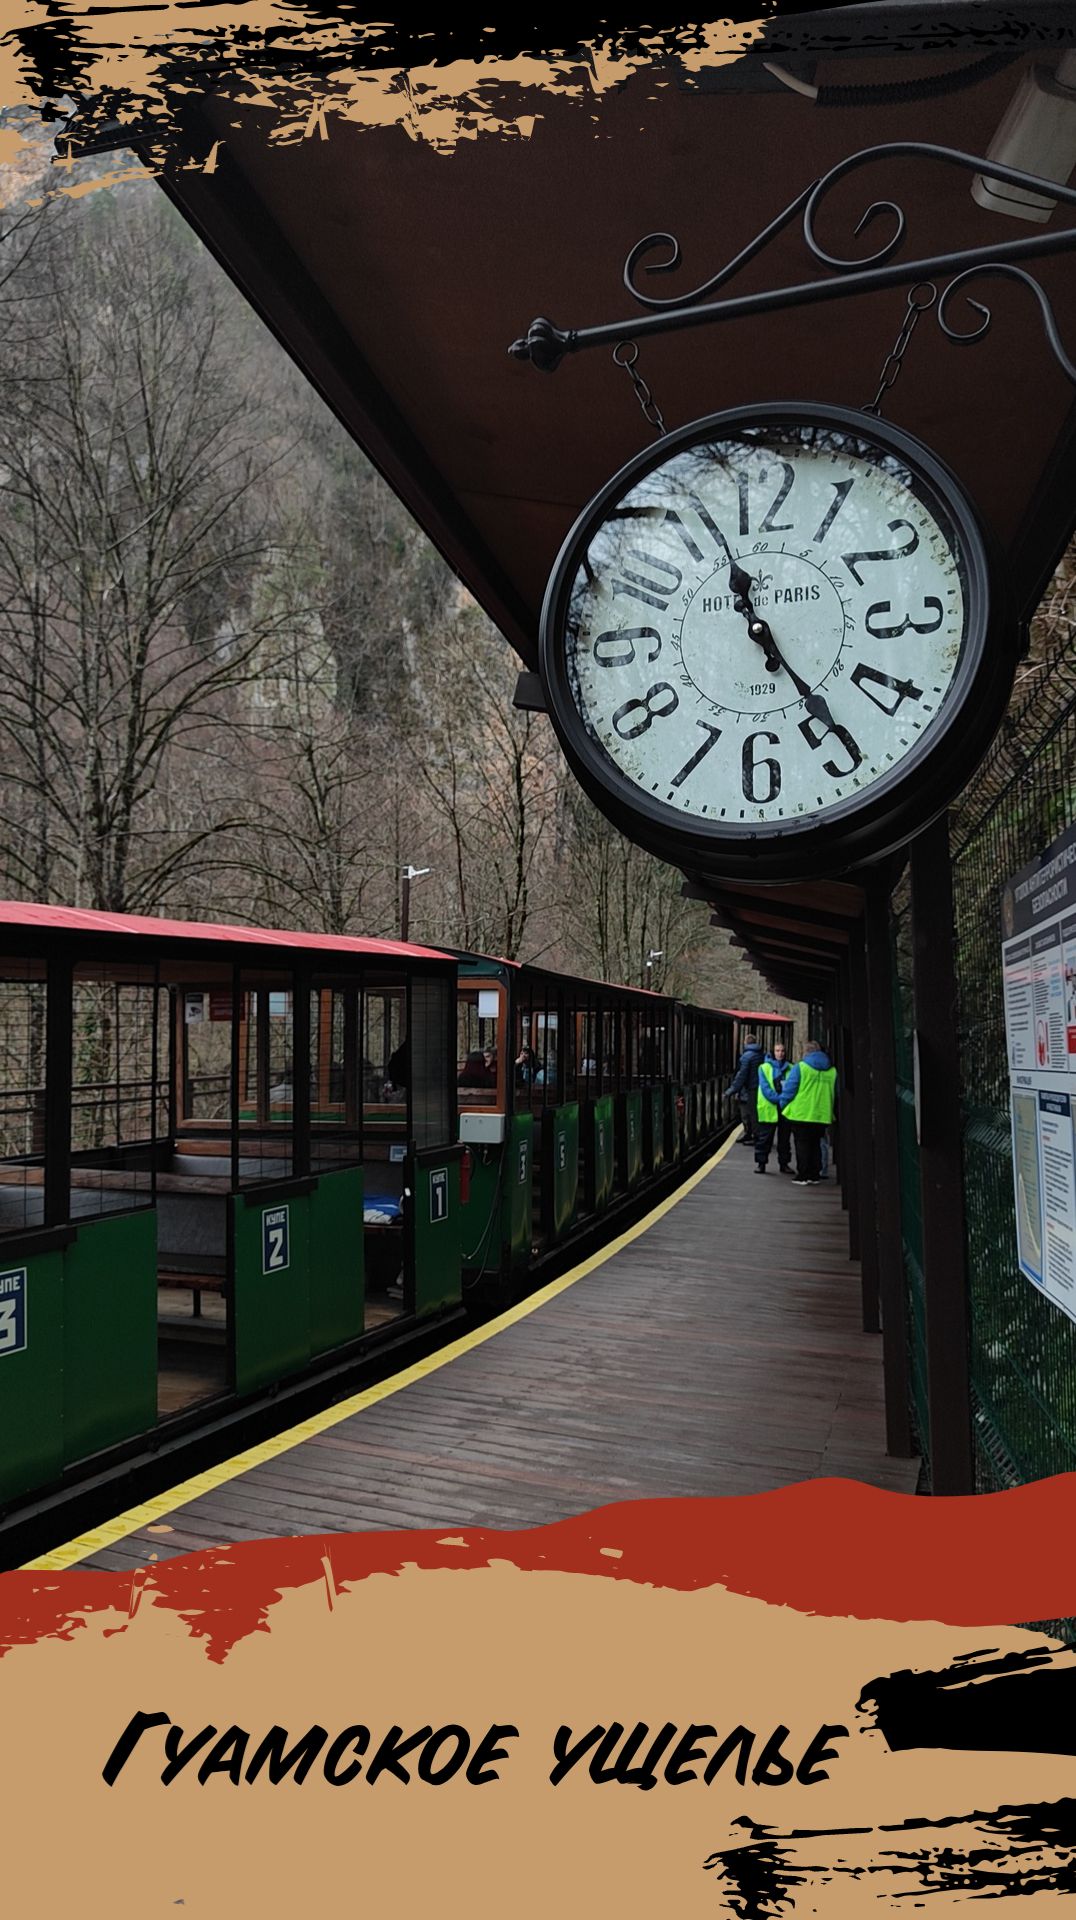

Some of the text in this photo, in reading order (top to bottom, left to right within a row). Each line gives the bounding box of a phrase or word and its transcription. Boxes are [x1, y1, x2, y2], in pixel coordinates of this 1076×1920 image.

[736, 462, 796, 536] 12
[812, 477, 856, 544] 1
[660, 490, 725, 563] 11
[752, 542, 769, 552] 60
[800, 549, 813, 558] 5
[840, 518, 920, 587] 2
[712, 554, 727, 571] 55
[611, 550, 683, 612] 10
[754, 595, 769, 607] de
[775, 584, 821, 604] PARIS
[830, 576, 845, 588] 10
[682, 588, 694, 606] 50
[844, 615, 856, 631] 15
[865, 596, 944, 640] 3
[593, 626, 662, 668] 9
[670, 633, 681, 651] 45
[680, 674, 693, 687] 40
[832, 658, 845, 678] 20
[750, 683, 776, 696] 1929
[850, 662, 924, 717] 4
[612, 682, 680, 740] 8
[708, 705, 727, 717] 35
[752, 713, 771, 723] 30
[670, 719, 723, 788] 7
[798, 713, 863, 778] 5
[741, 731, 782, 803] 6
[436, 1186, 443, 1216] 1
[266, 1211, 286, 1226] КУПЕ
[269, 1228, 284, 1267] 2
[0, 1298, 16, 1350] 3
